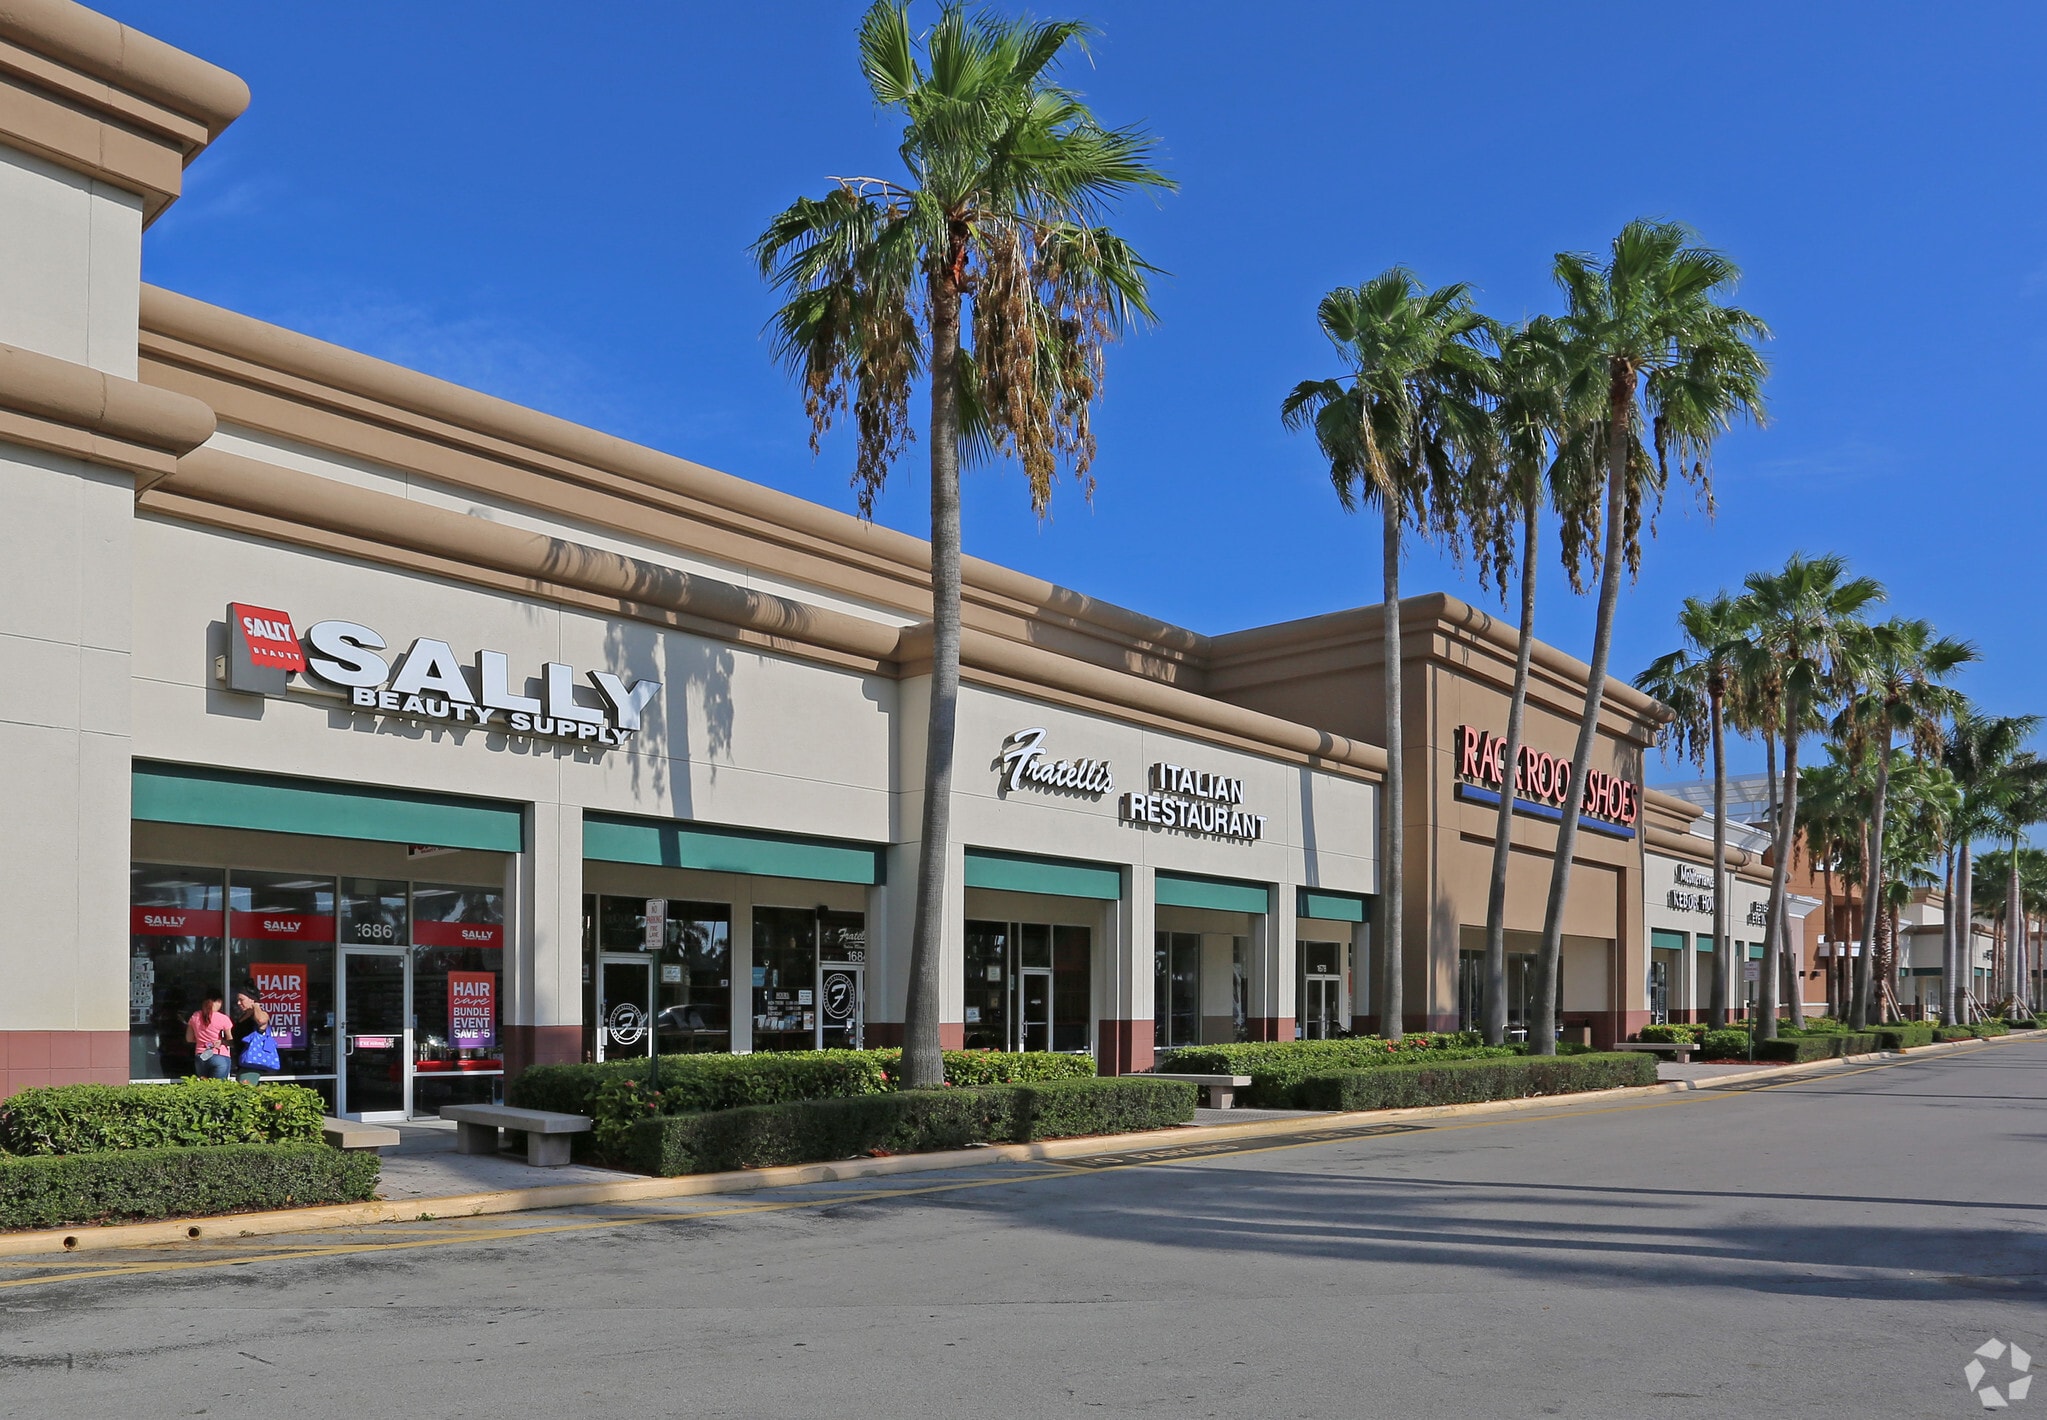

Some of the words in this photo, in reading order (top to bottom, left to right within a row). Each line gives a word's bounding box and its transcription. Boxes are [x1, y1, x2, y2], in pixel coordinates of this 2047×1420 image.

[243, 617, 294, 643] SALLY
[253, 646, 300, 660] BEAUTY
[310, 620, 663, 731] SALLY
[353, 687, 495, 724] BEAUTY
[510, 713, 632, 745] SUPPLY
[1160, 762, 1245, 804] ITALIAN
[1526, 746, 1584, 808] ROO
[1587, 768, 1639, 824] SHOES
[1131, 792, 1269, 840] RESTAURANT
[144, 915, 186, 925] SALLY
[263, 921, 302, 930] SALLY
[461, 929, 493, 939] SALLY
[838, 928, 866, 943] Fratel
[847, 950, 866, 962] 168
[256, 974, 302, 991] HAIR
[453, 981, 490, 997] HAIR
[453, 997, 491, 1006] care
[453, 1007, 491, 1017] BUNDLE
[268, 1013, 302, 1026] VENT
[453, 1017, 491, 1029] EVENT
[454, 1028, 479, 1039] SAVE
